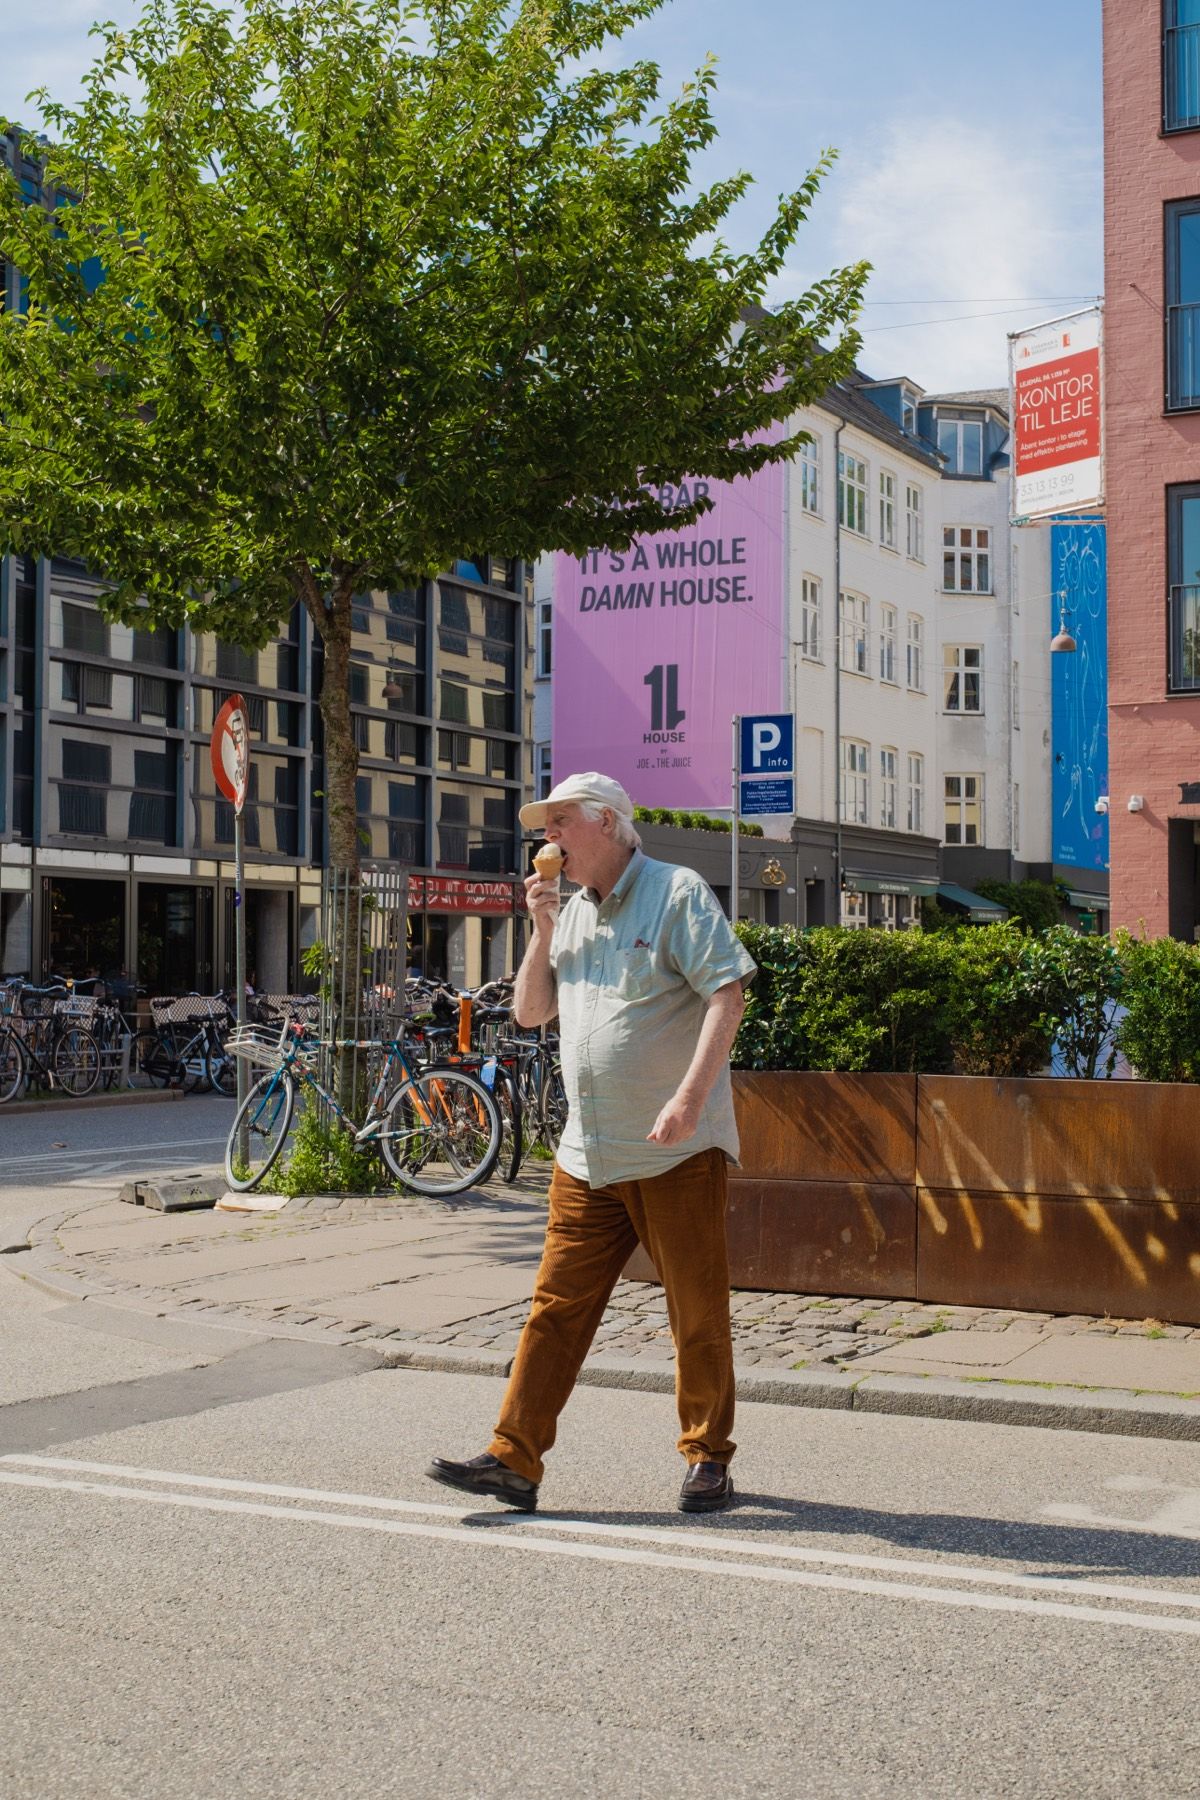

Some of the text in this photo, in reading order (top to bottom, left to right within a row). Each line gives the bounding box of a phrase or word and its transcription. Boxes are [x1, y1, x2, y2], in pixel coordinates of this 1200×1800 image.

[1019, 373, 1093, 411] KONTOR
[1021, 396, 1092, 432] TIL LEJE
[631, 545, 649, 571] A
[656, 537, 746, 569] WHOLE
[579, 576, 753, 612] DAMN HOUSE.
[643, 732, 686, 744] HOUSE
[752, 722, 782, 767] P
[768, 757, 788, 767] info
[636, 758, 650, 769] JOE
[656, 757, 670, 769] THE
[671, 756, 692, 768] JUICE
